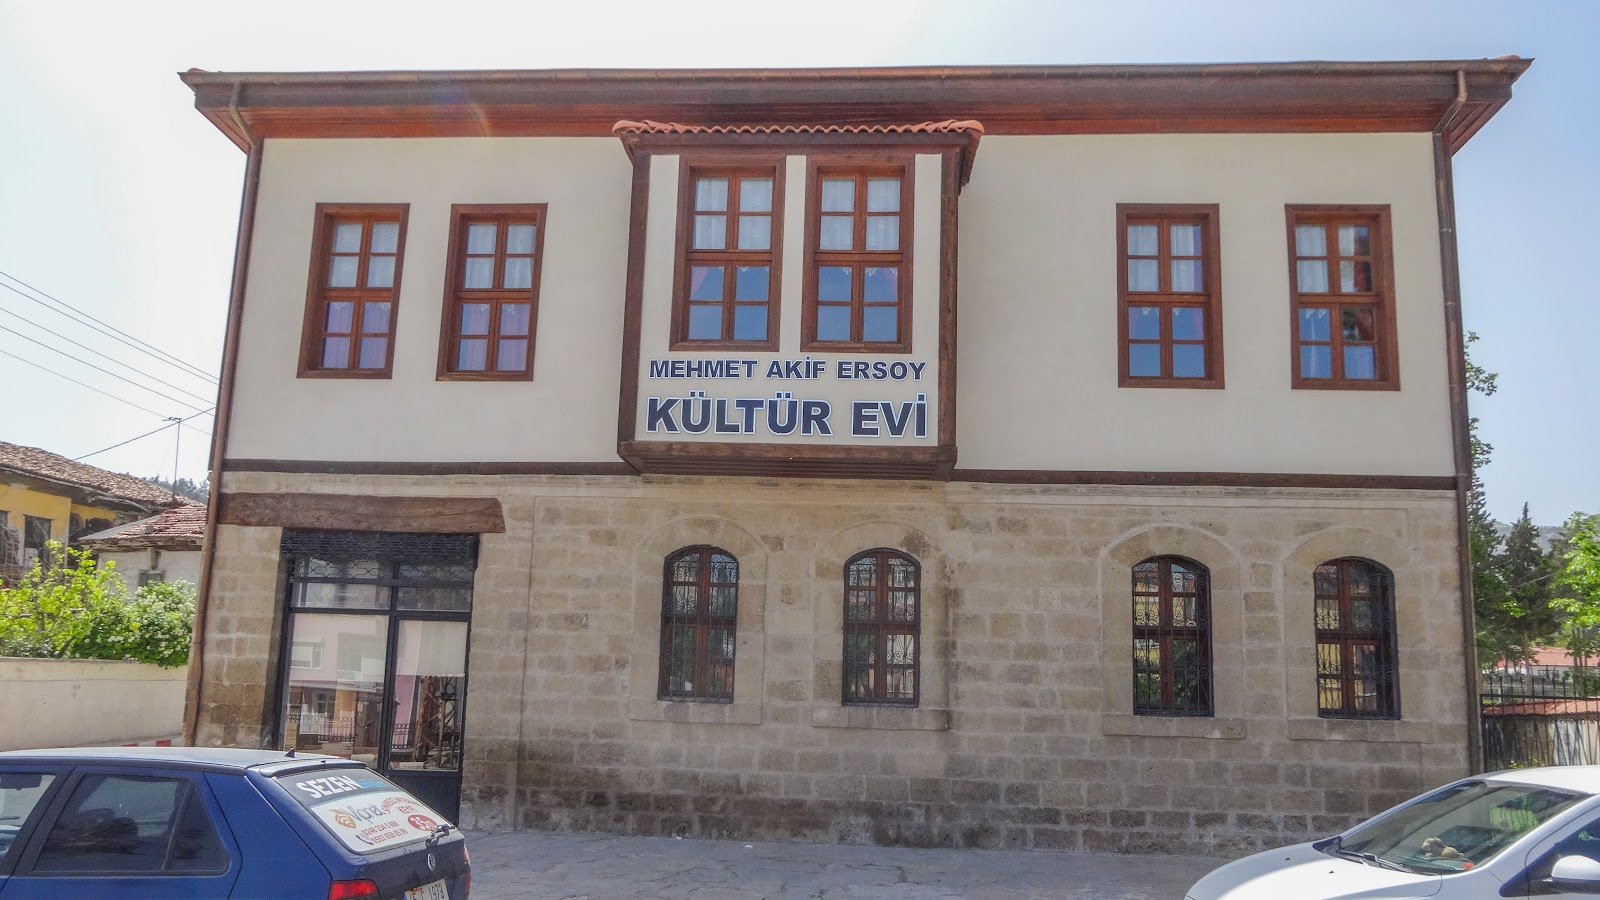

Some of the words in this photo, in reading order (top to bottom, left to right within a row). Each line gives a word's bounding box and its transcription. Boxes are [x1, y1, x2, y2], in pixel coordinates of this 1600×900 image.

[649, 359, 758, 379] MEHMET
[766, 356, 826, 380] AKİF
[836, 360, 927, 381] ERSOY
[646, 390, 833, 436] KÜLTÜR
[851, 393, 927, 438] EVİ
[296, 775, 364, 799] SEZEN
